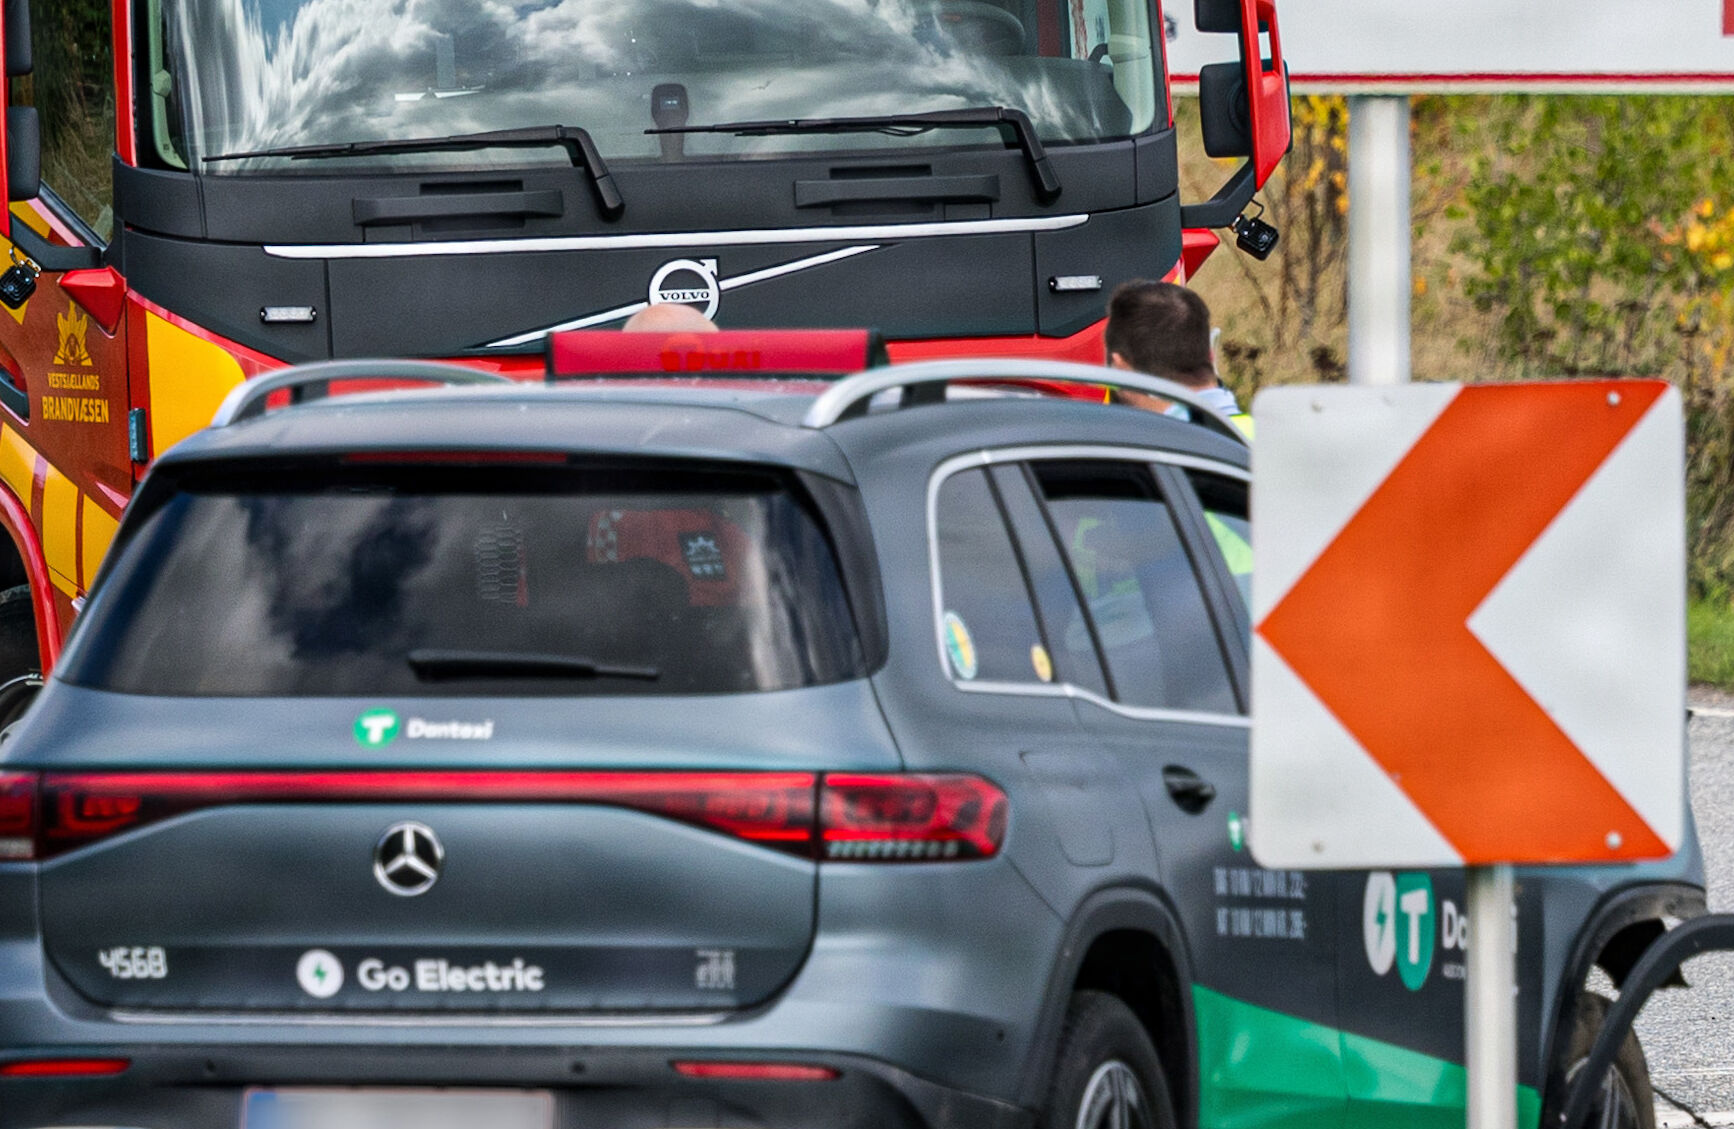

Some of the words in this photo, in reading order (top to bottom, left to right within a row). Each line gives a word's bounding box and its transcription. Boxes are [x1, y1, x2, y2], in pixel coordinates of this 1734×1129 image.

[660, 291, 710, 301] VOLVO
[42, 396, 110, 423] BRANDVÆSEN
[99, 946, 168, 979] 4568
[357, 957, 410, 992] Go
[414, 957, 545, 992] Electric
